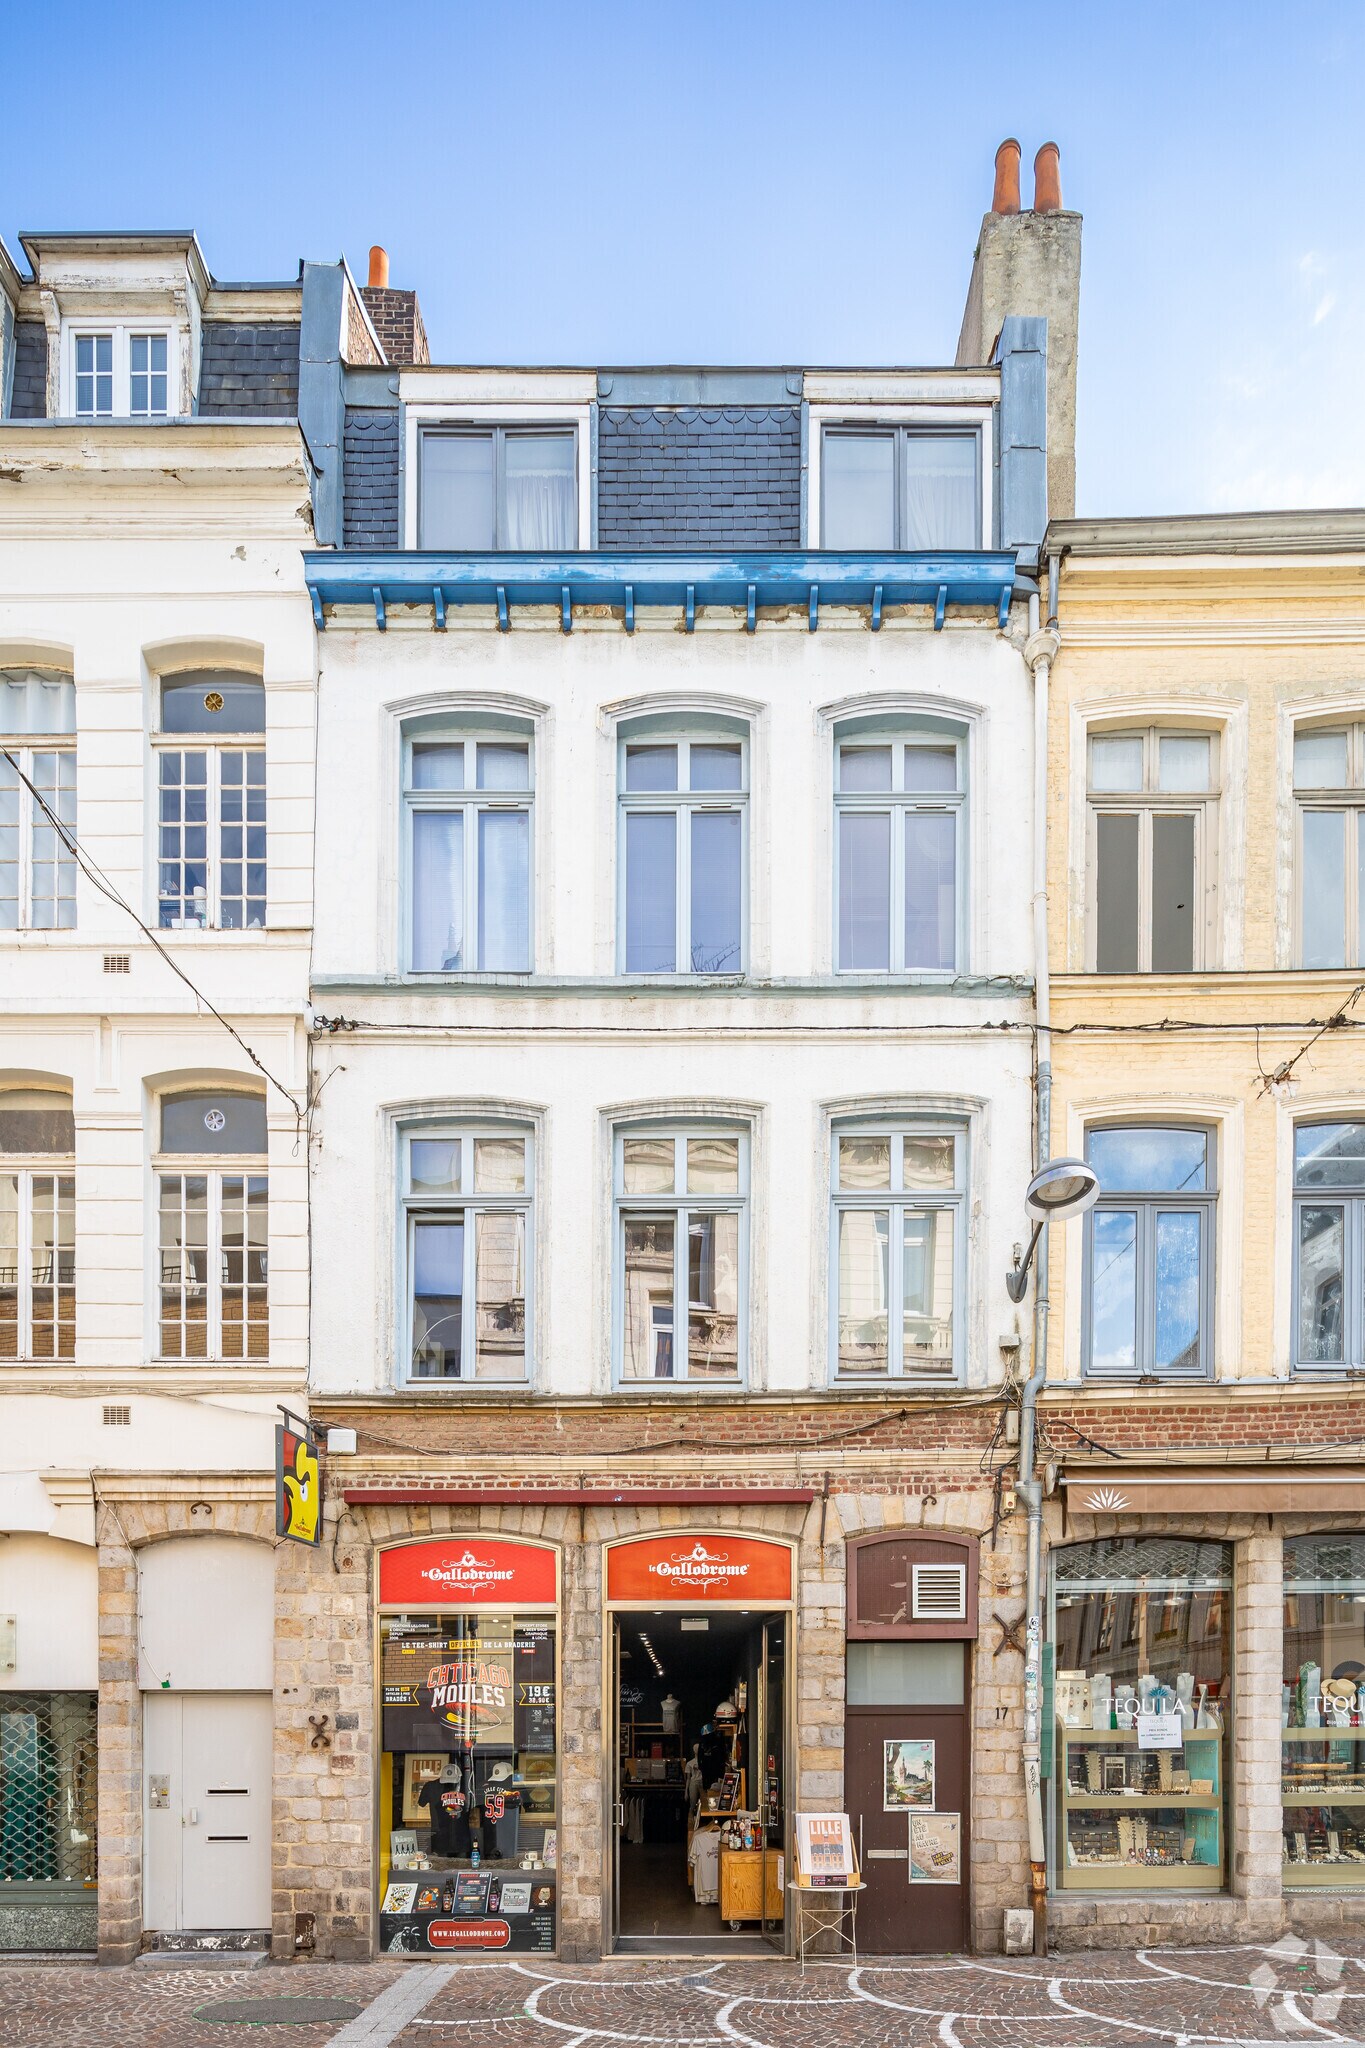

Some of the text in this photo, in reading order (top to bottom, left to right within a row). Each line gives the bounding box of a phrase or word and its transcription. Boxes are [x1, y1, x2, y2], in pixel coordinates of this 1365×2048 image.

[428, 1568, 514, 1581] Gallodrome
[656, 1562, 748, 1576] Gallodrome
[426, 1662, 510, 1688] CHTICAGO
[431, 1684, 506, 1708] MOULES
[996, 1707, 1008, 1720] 17
[485, 1794, 504, 1818] 59
[810, 1821, 841, 1834] LILLE
